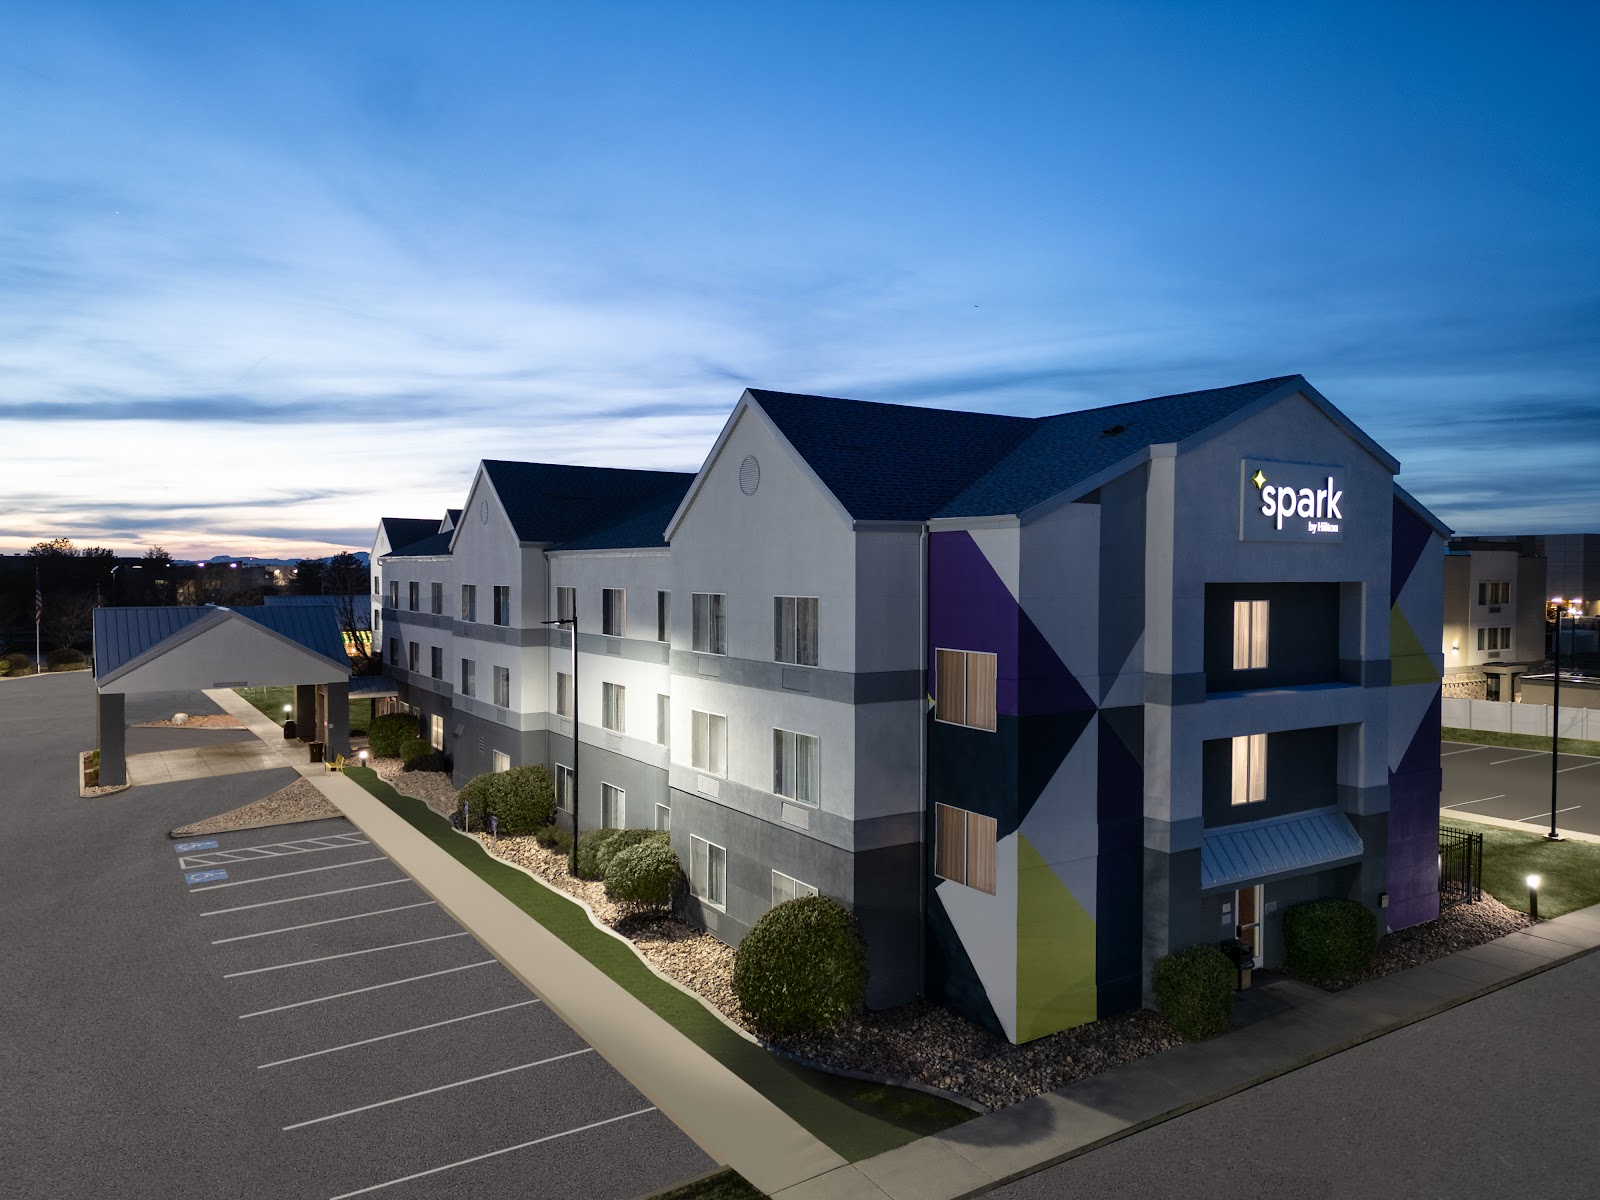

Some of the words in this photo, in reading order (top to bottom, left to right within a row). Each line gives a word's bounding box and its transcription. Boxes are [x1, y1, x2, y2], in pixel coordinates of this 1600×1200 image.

[1261, 476, 1342, 530] spark
[1308, 521, 1317, 534] by
[1317, 521, 1339, 533] Hilton
